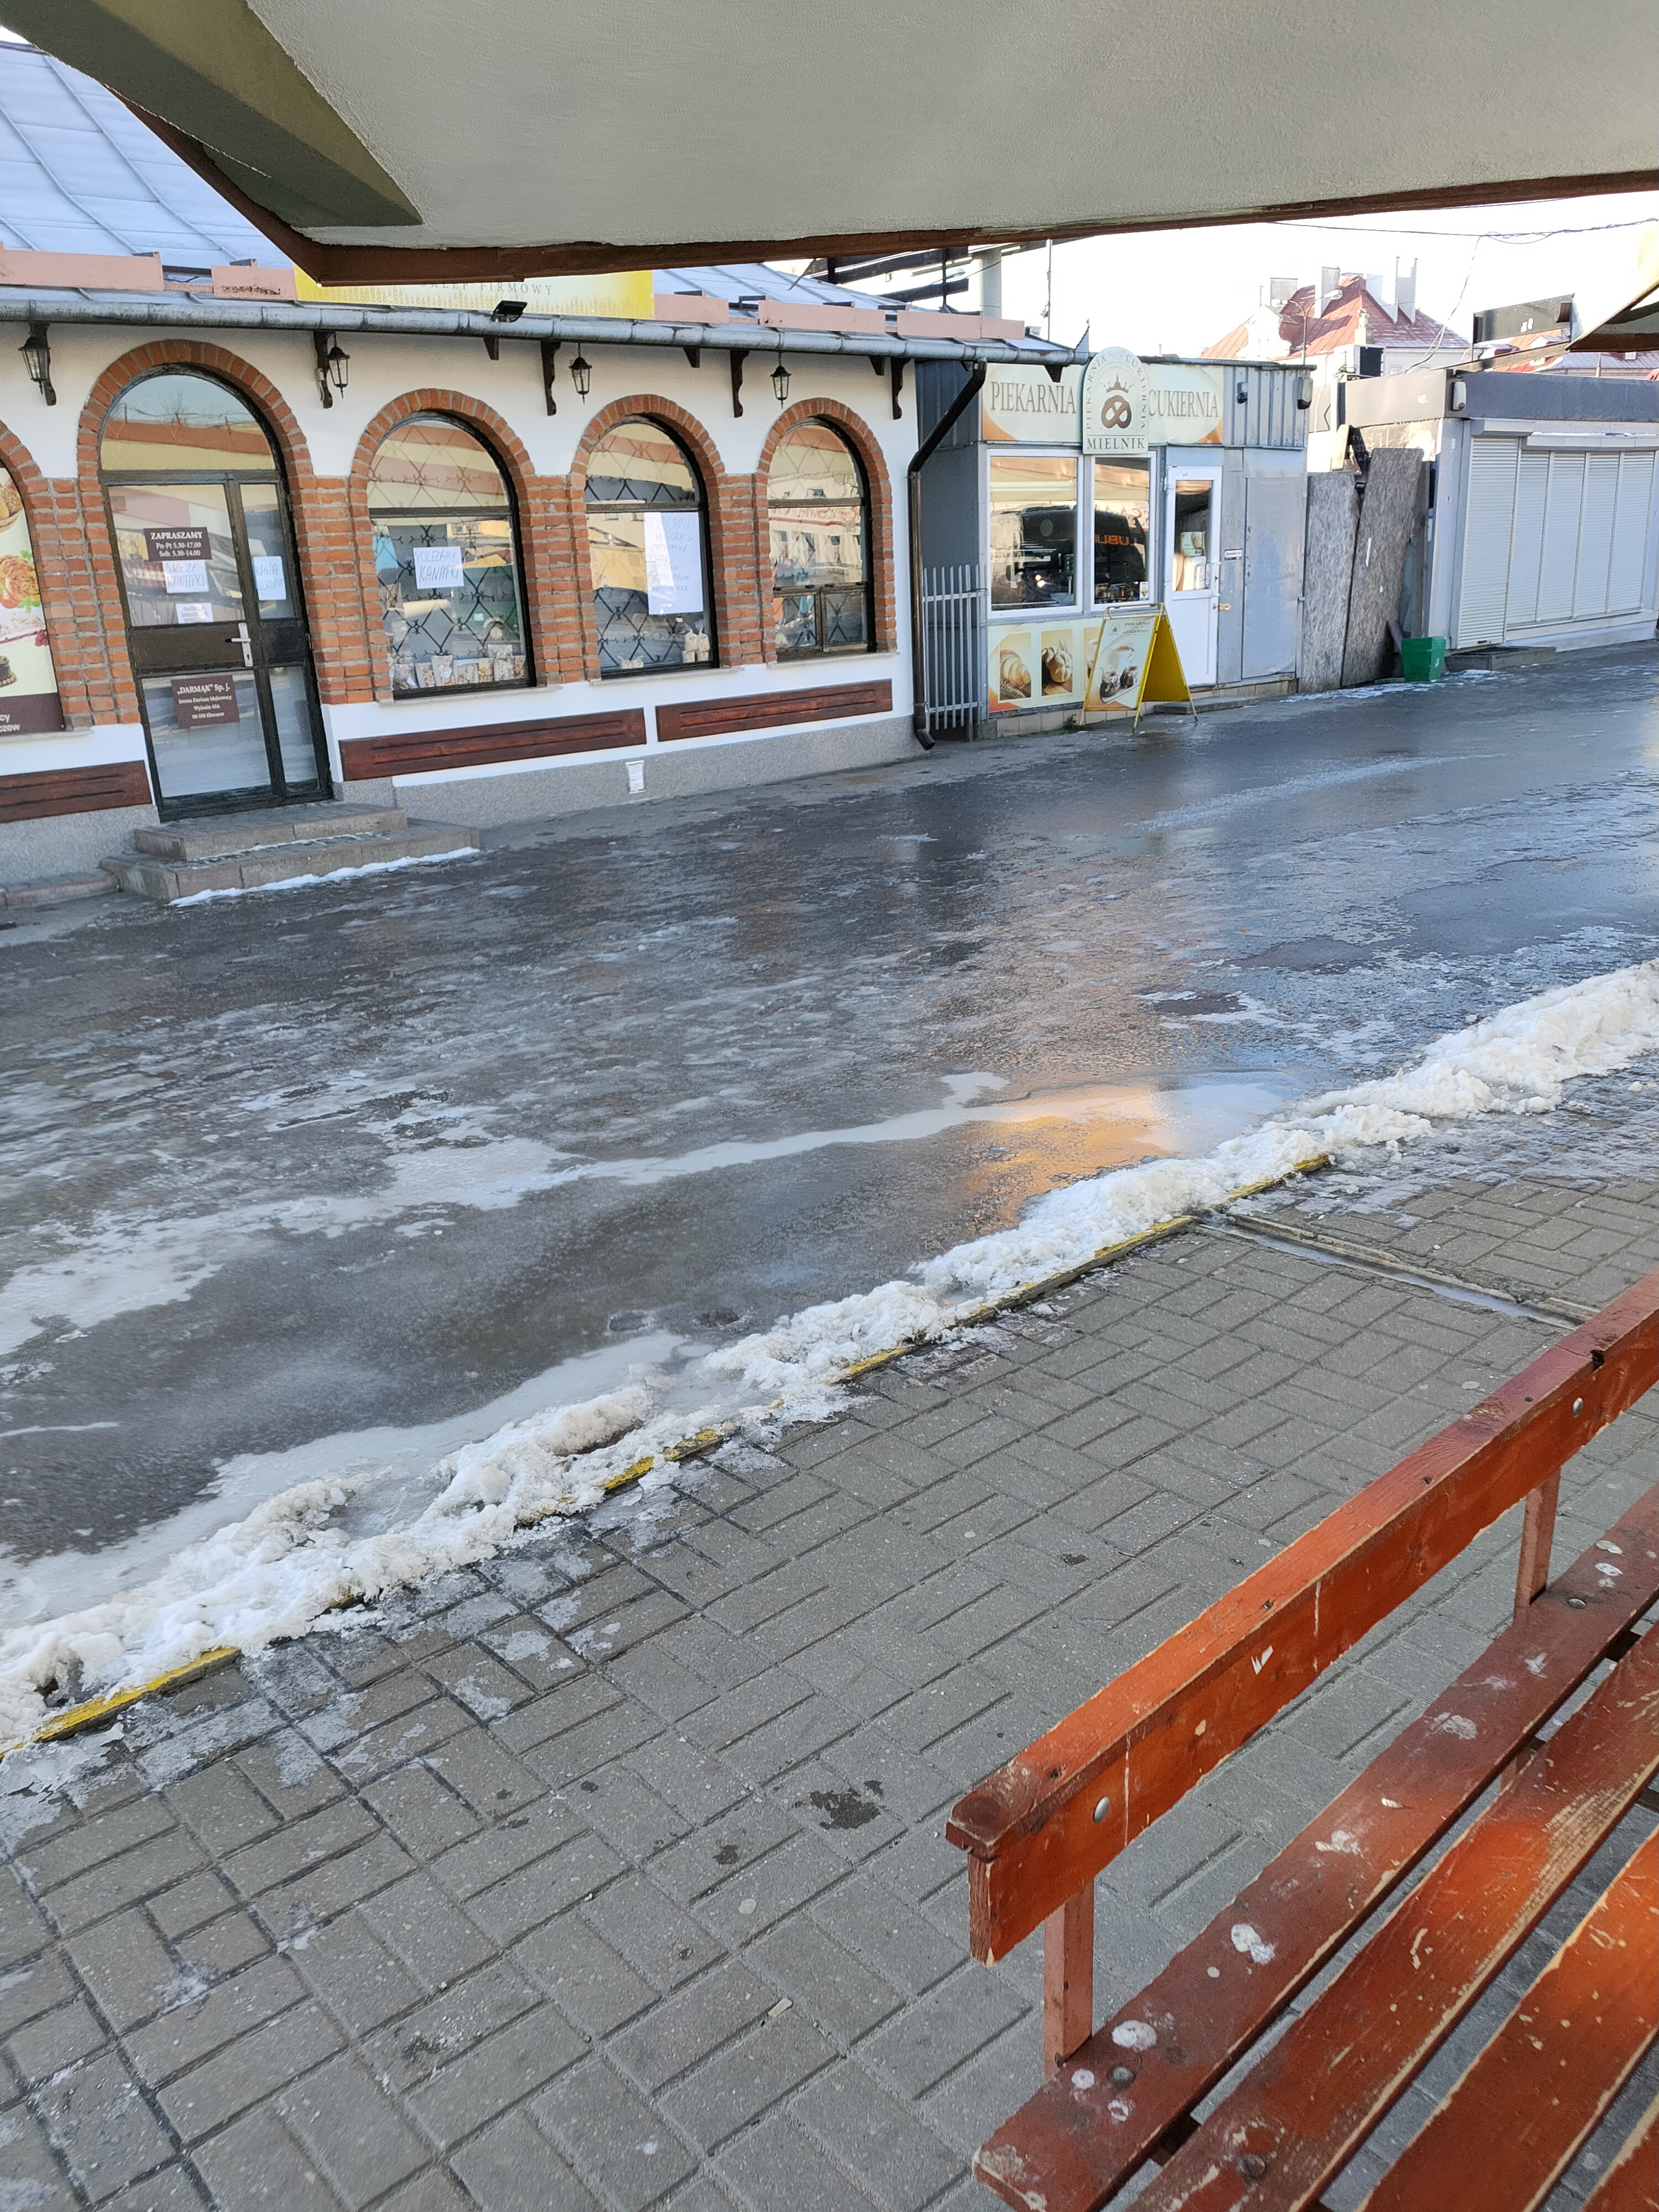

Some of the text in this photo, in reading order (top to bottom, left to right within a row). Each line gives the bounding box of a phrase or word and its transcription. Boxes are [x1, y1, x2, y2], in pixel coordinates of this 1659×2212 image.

[481, 282, 553, 295] FIRMOWY
[990, 380, 1220, 418] PIEKARNIA CUKIERNIA
[1087, 354, 1107, 429] PIEKARNIA
[1126, 354, 1147, 429] CUKIERNIA
[1087, 437, 1145, 450] MIELNIK
[150, 531, 203, 540] ZAPRASZAMY
[419, 565, 459, 583] KANAPKI
[214, 684, 225, 692] Sp.
[225, 682, 231, 692] j.
